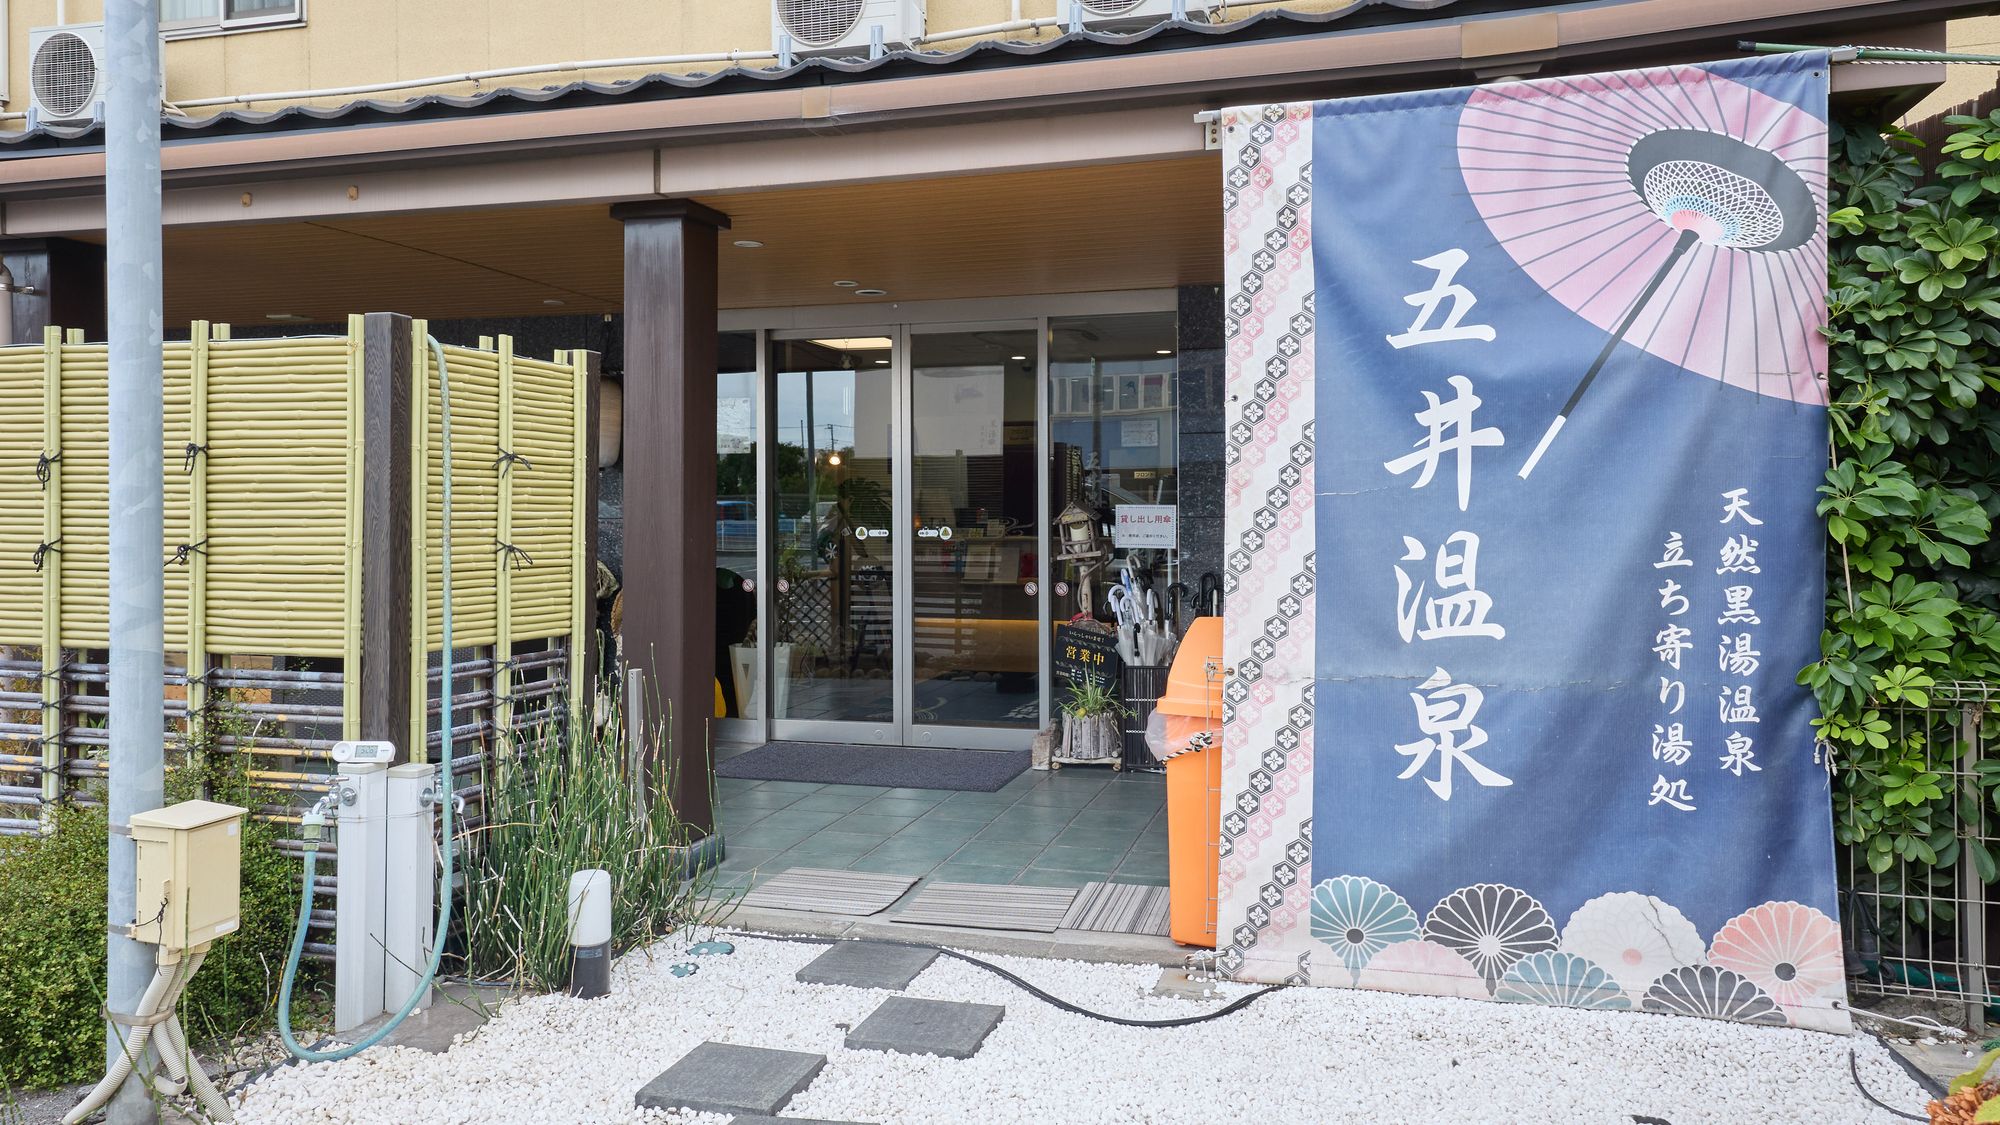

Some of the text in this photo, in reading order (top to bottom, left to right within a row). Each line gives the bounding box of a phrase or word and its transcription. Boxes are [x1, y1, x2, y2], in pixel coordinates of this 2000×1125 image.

[1065, 645, 1105, 666] 営業中
[1120, 514, 1172, 524] 貸し出し用傘
[1384, 248, 1513, 801] 五井温泉
[1716, 488, 1763, 777] 天然黒湯温泉
[1648, 531, 1697, 811] 立ち寄り湯処
